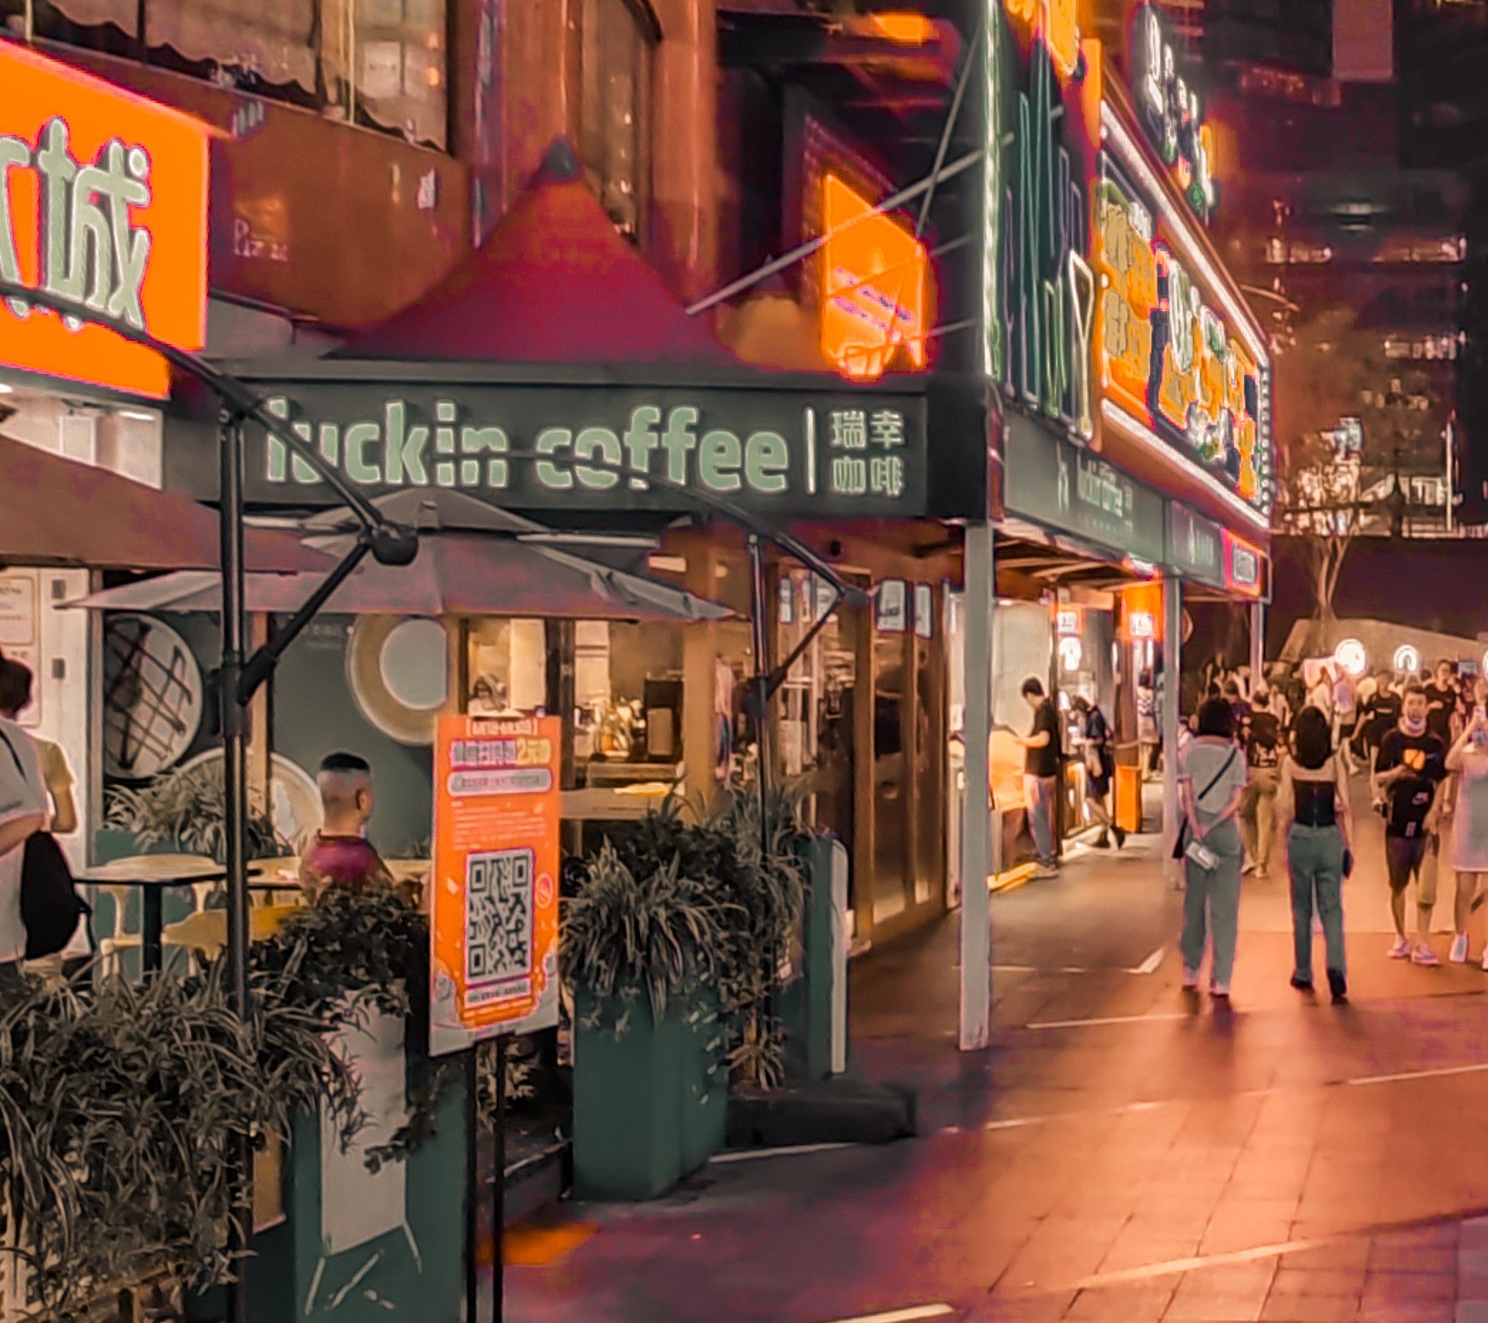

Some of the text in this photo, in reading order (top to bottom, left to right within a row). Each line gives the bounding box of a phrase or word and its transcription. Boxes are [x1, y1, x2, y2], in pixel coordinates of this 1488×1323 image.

[266, 397, 790, 491] luckin coffee
[830, 409, 904, 450] 瑞幸
[830, 455, 904, 497] 咖啡
